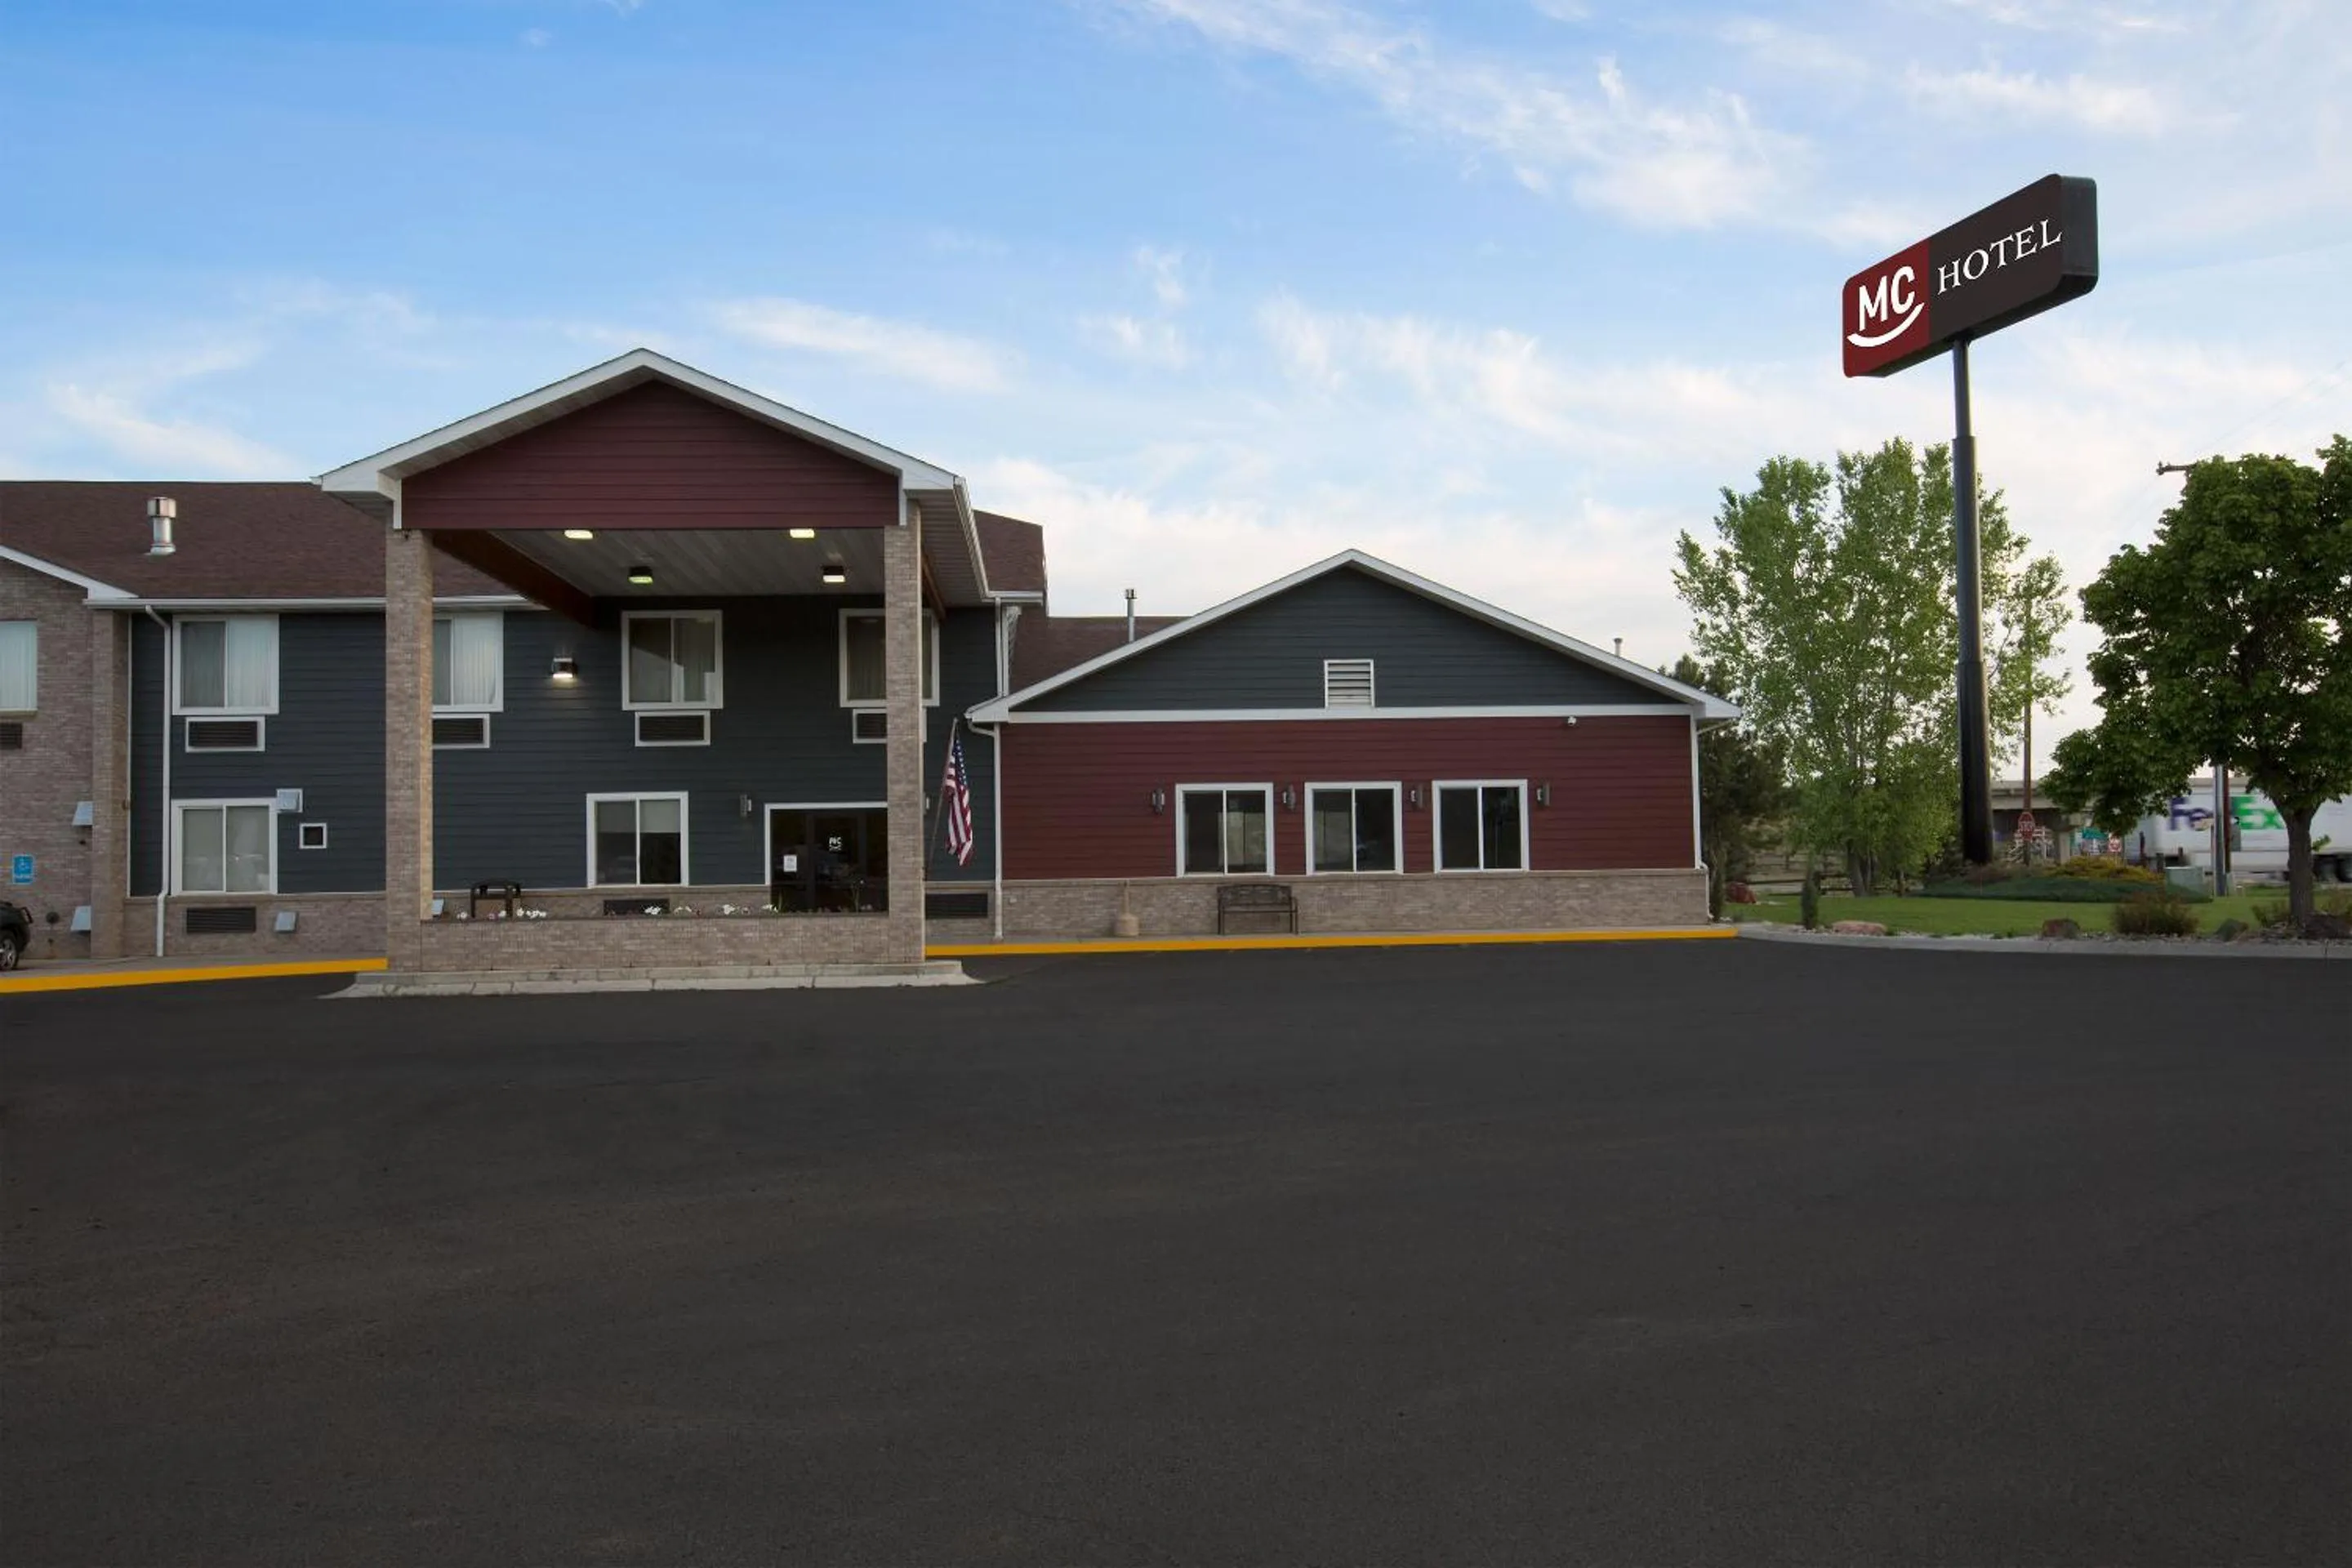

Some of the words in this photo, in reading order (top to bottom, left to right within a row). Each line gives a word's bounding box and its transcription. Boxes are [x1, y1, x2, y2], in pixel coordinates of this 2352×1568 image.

[1859, 266, 1916, 332] MC
[1937, 219, 2063, 295] HOTEL
[2170, 796, 2285, 831] FeEx
